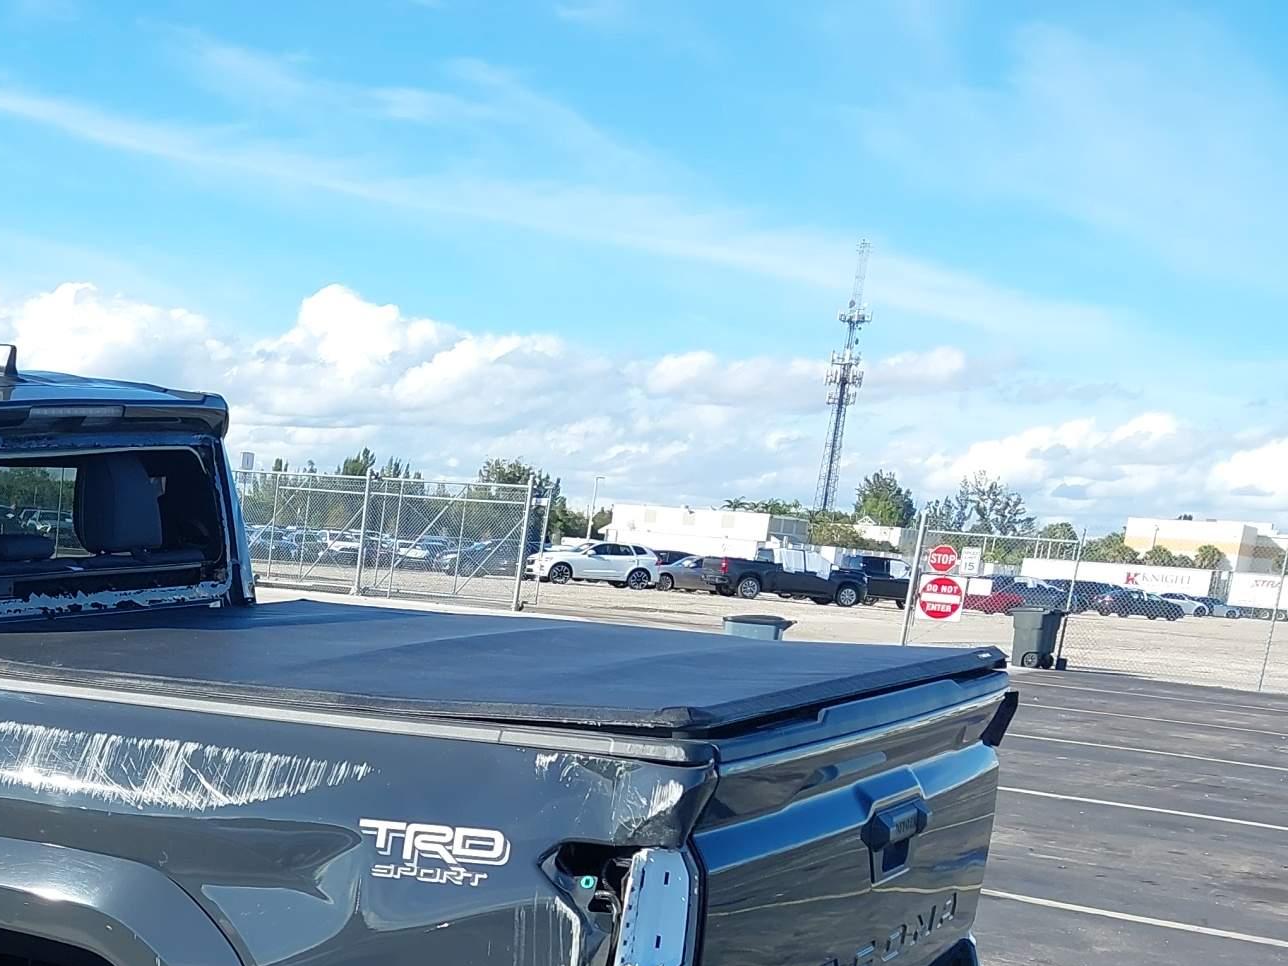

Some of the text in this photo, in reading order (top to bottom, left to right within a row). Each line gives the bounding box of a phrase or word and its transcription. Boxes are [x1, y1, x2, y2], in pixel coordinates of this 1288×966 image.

[930, 553, 956, 565] STOP
[964, 561, 975, 571] 15
[1142, 572, 1192, 585] KNIGHT
[926, 583, 959, 593] DO NOT
[926, 603, 952, 612] ENTER
[359, 818, 511, 866] TRD
[370, 863, 489, 887] SPORT
